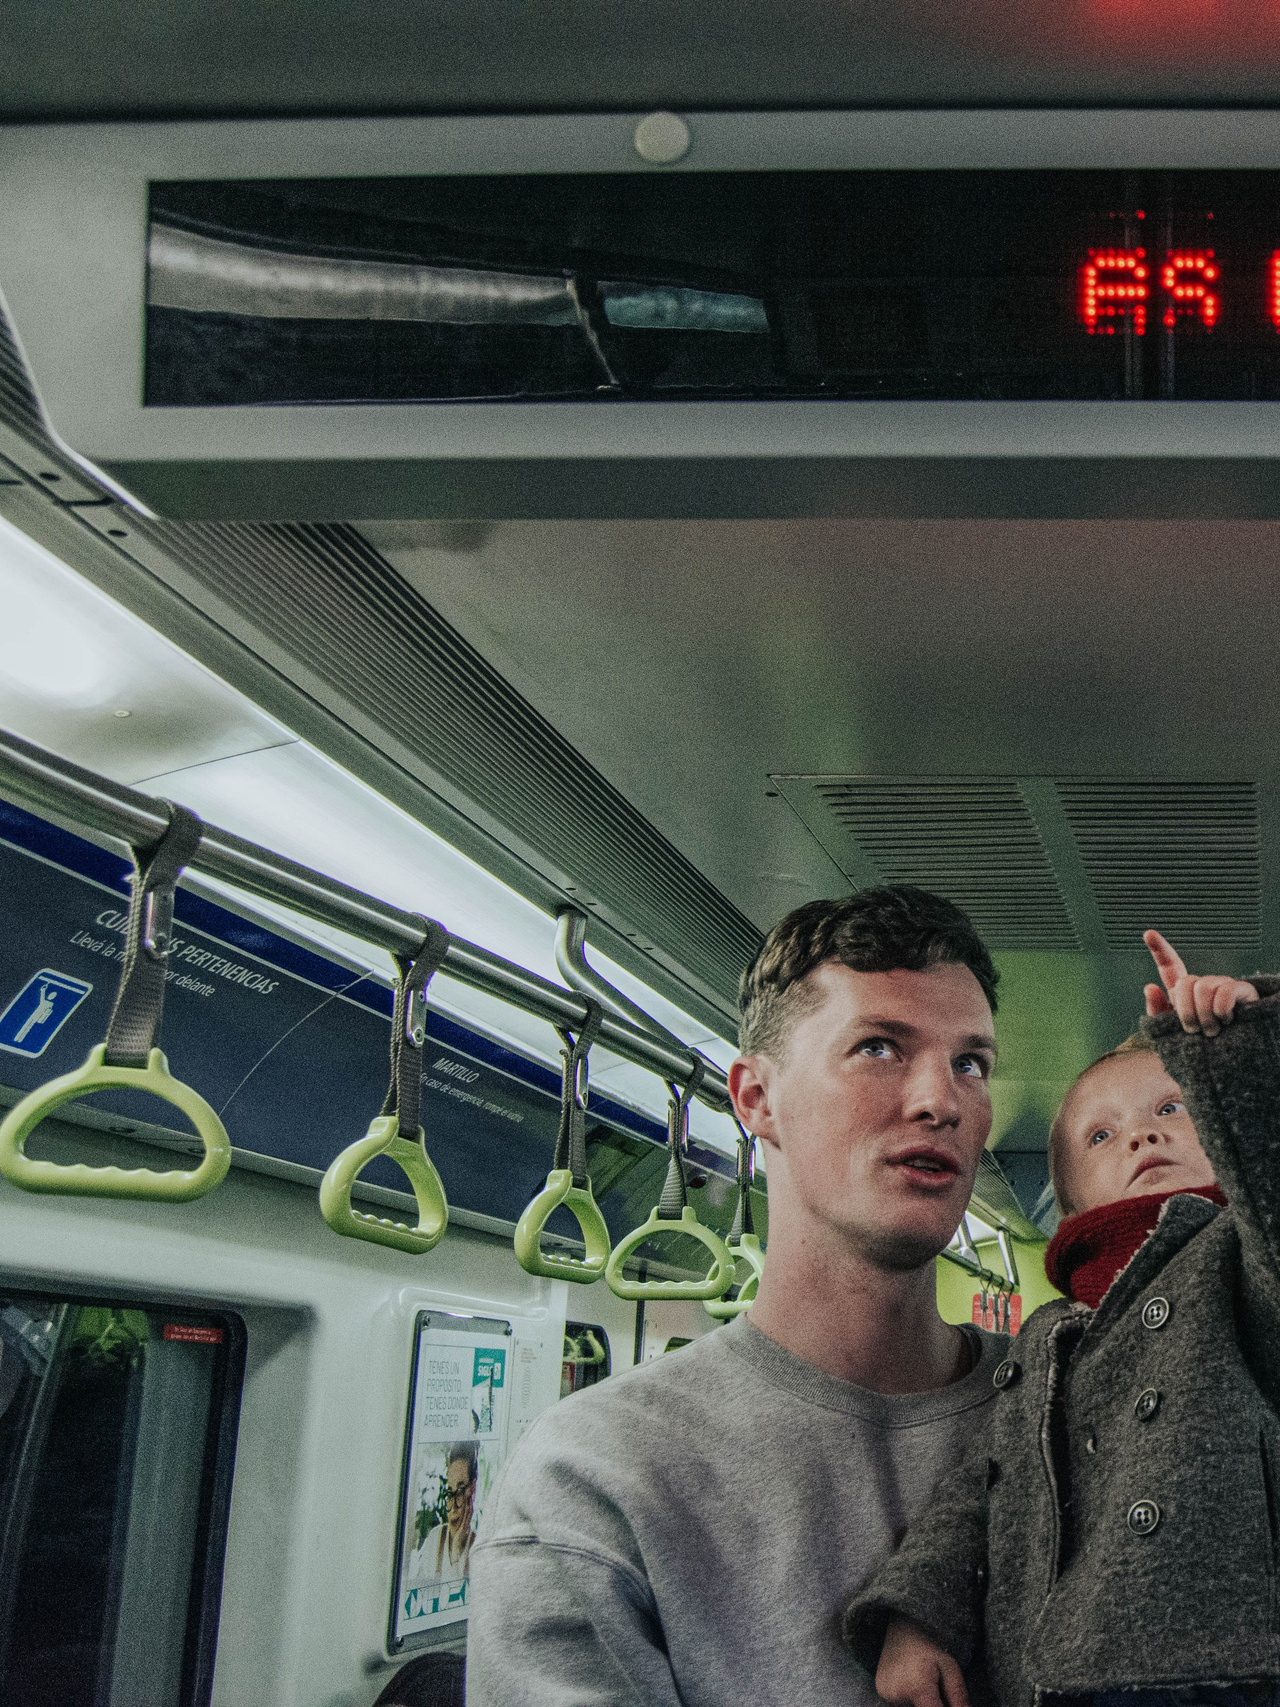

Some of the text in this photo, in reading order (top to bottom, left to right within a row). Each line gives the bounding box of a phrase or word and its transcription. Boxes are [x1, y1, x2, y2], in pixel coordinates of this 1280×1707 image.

[69, 930, 107, 952] Llevá
[101, 942, 117, 957] la
[175, 974, 216, 997] delante
[176, 944, 280, 995] PERTENENCIAS
[431, 1057, 480, 1083] MARTILLO
